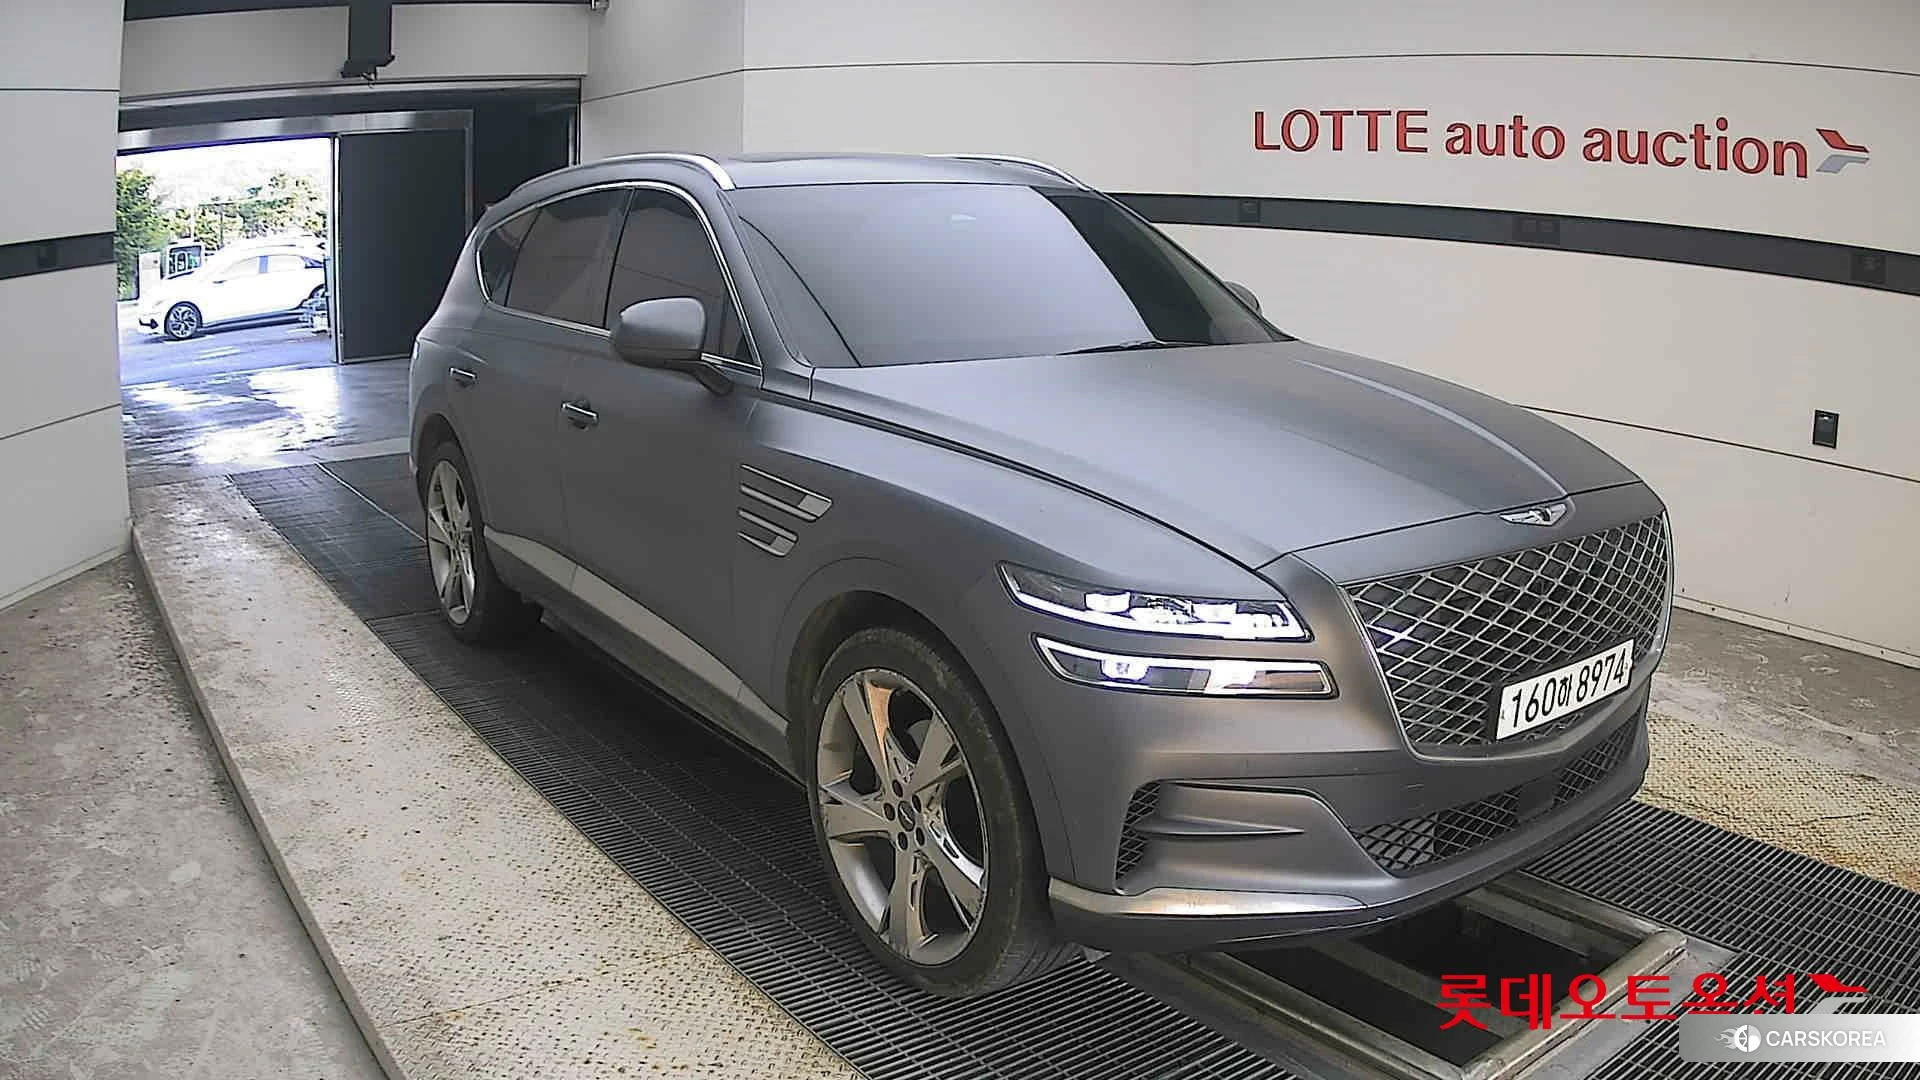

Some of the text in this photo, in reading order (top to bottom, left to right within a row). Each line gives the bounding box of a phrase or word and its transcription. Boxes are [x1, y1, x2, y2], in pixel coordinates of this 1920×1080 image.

[1253, 109, 1809, 178] LOTTE auto auction
[1576, 648, 1627, 703] 8974
